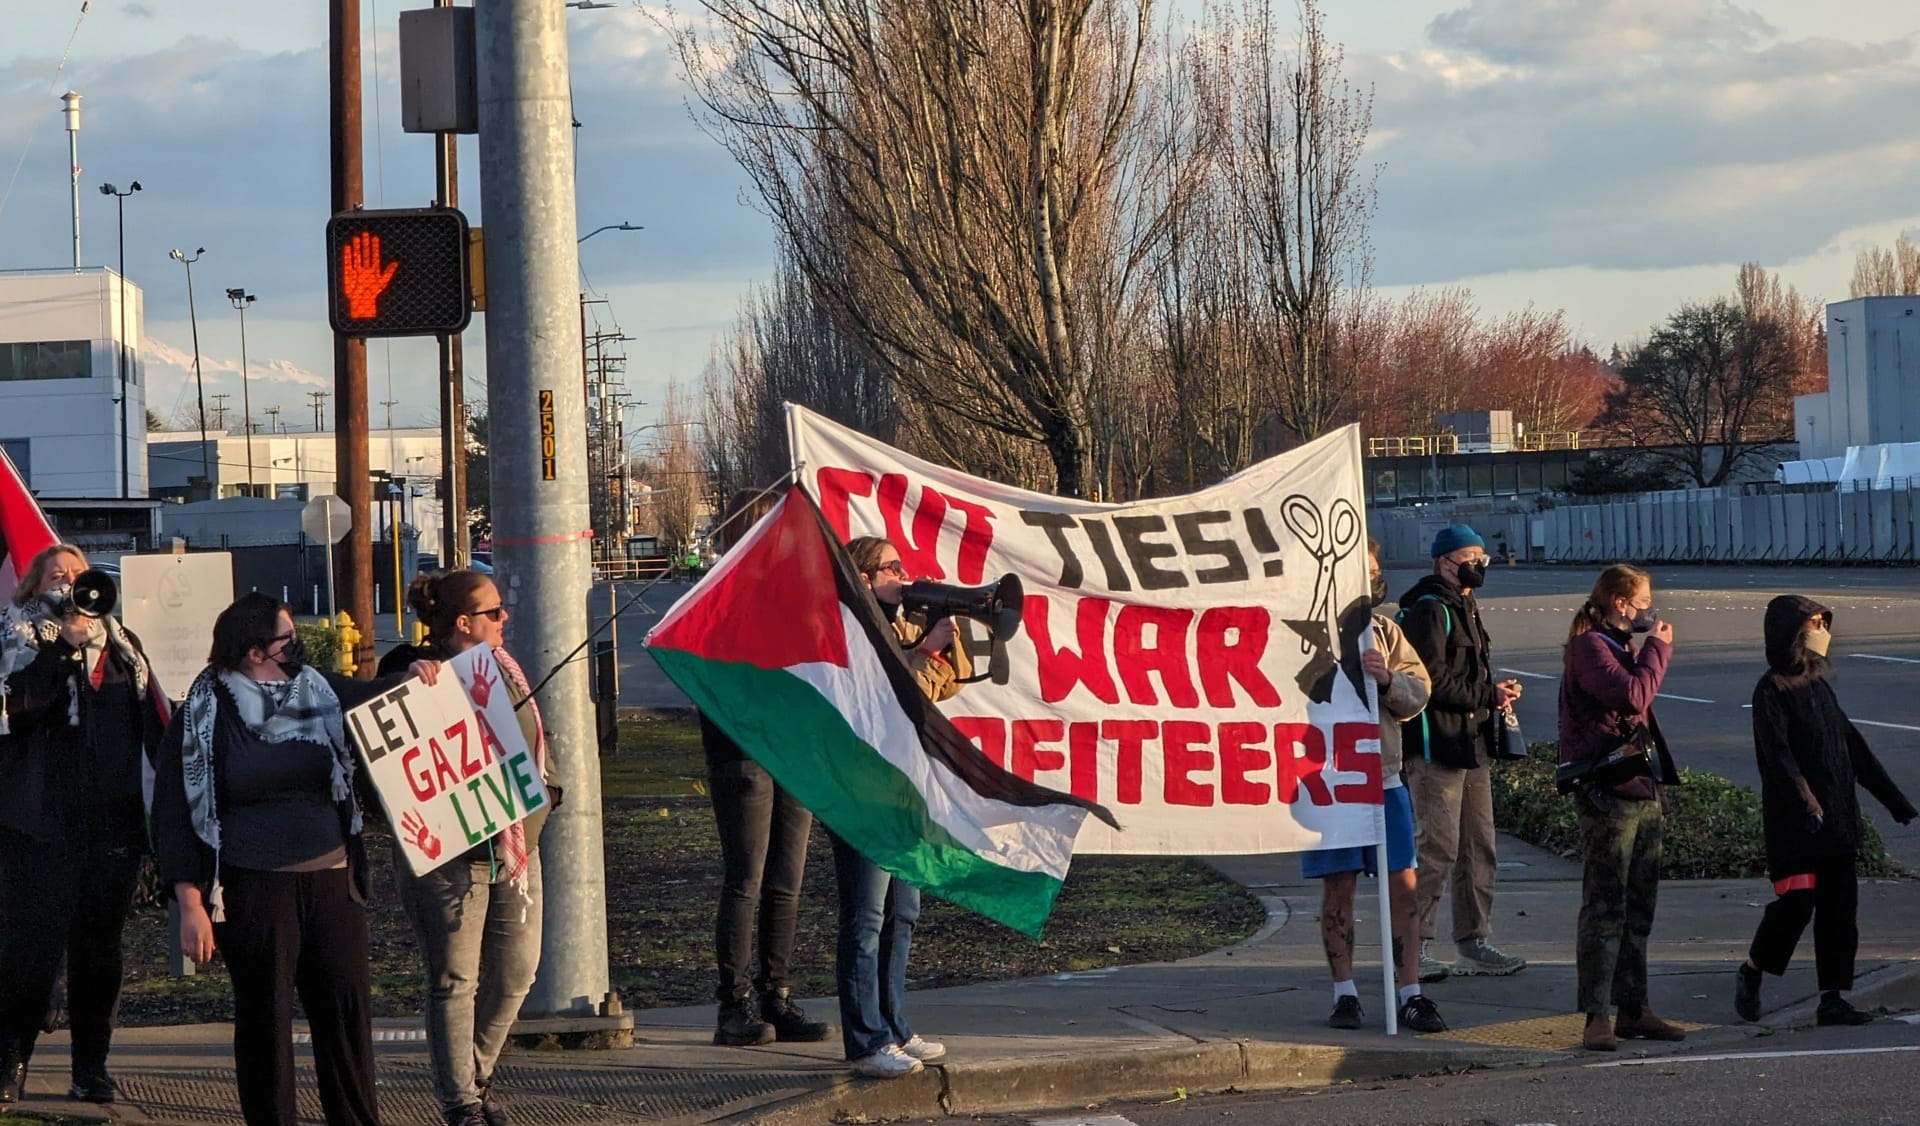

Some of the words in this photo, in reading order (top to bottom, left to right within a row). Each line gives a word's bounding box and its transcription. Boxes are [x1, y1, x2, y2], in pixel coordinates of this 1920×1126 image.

[541, 391, 554, 480] 2501
[1018, 507, 1284, 593] TIES!
[1022, 594, 1283, 709] WAR
[350, 684, 420, 764] LET
[401, 709, 507, 803] GAZA
[448, 751, 544, 846] LIVE
